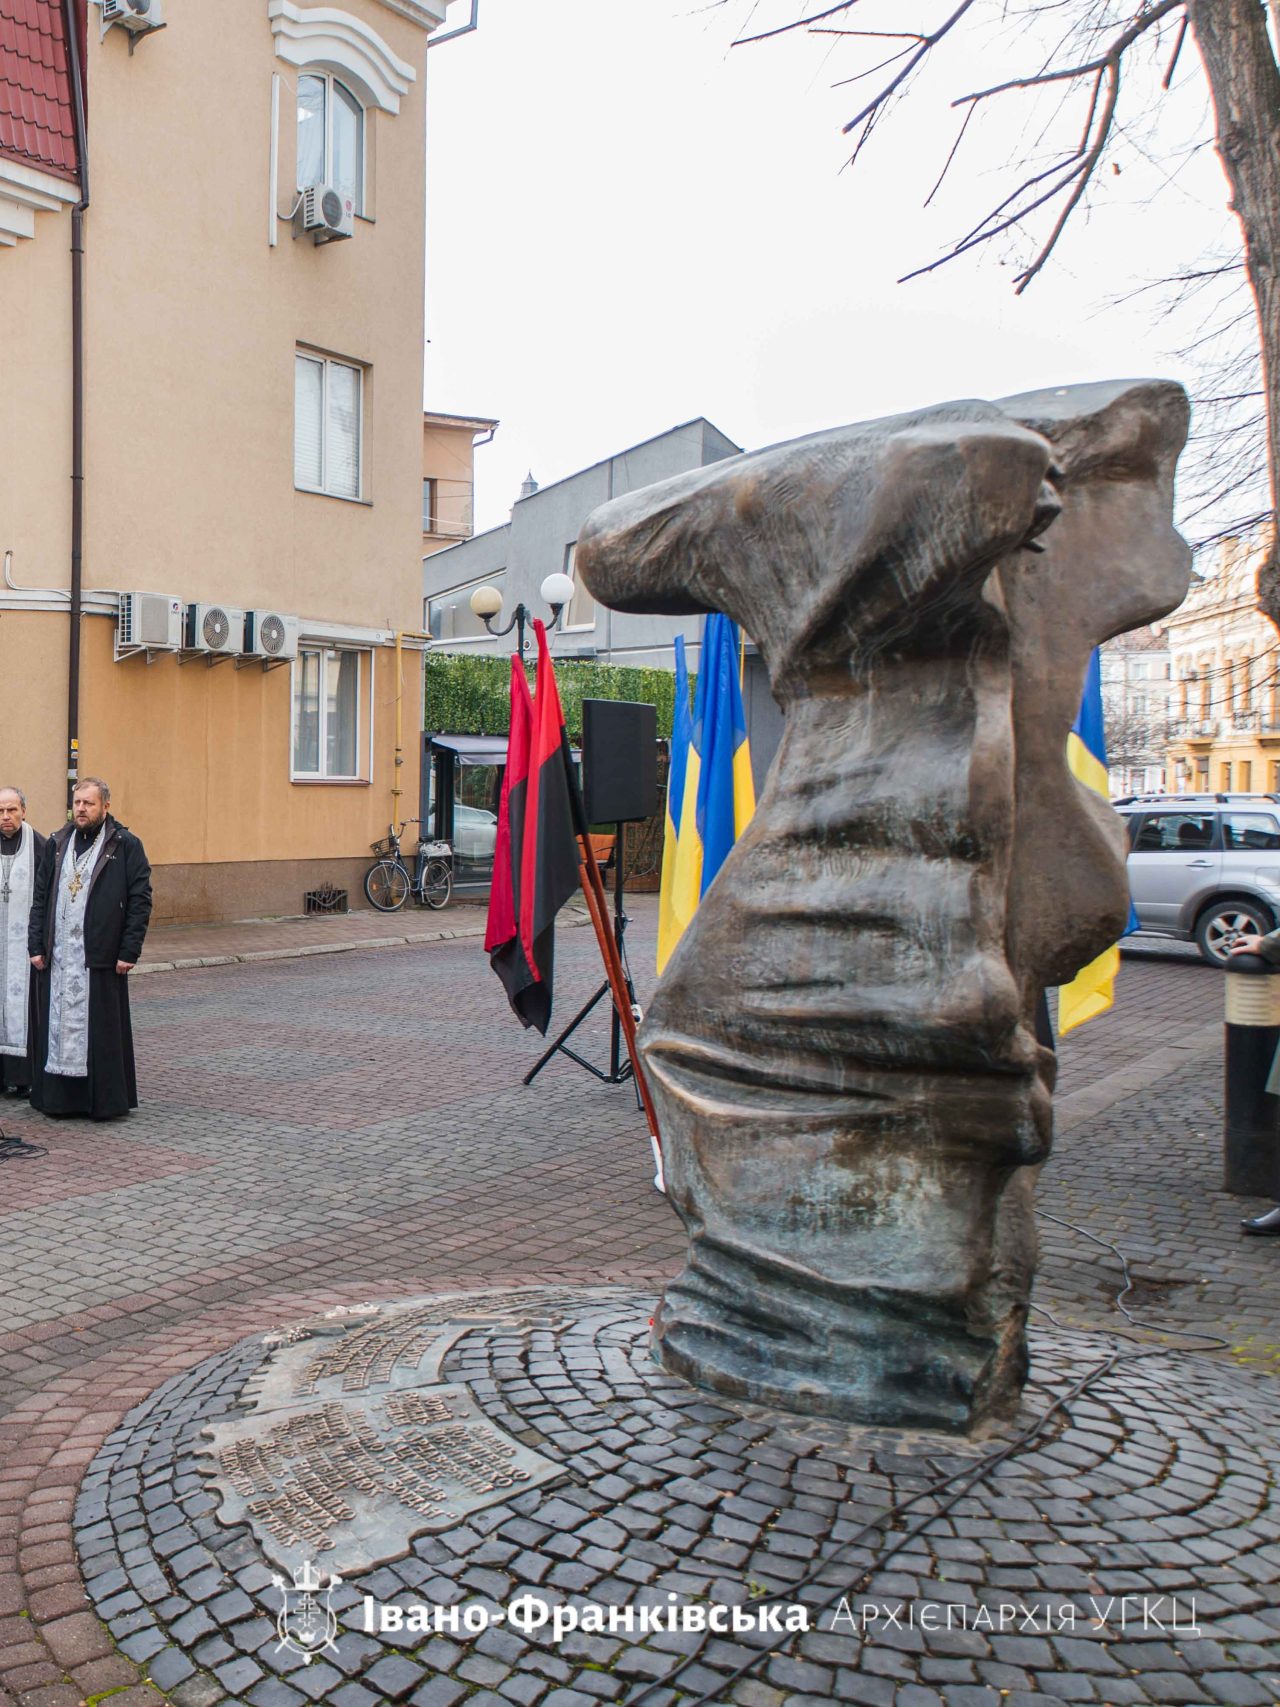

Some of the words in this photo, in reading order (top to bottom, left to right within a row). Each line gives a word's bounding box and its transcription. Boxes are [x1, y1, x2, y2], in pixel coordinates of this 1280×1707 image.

[278, 1477, 340, 1530] СМЕРЧУК
[287, 1459, 360, 1523] НАЛИВАЙКО
[244, 1498, 303, 1548] ШТУНЯК
[270, 1495, 336, 1551] ХРОМЕНКО
